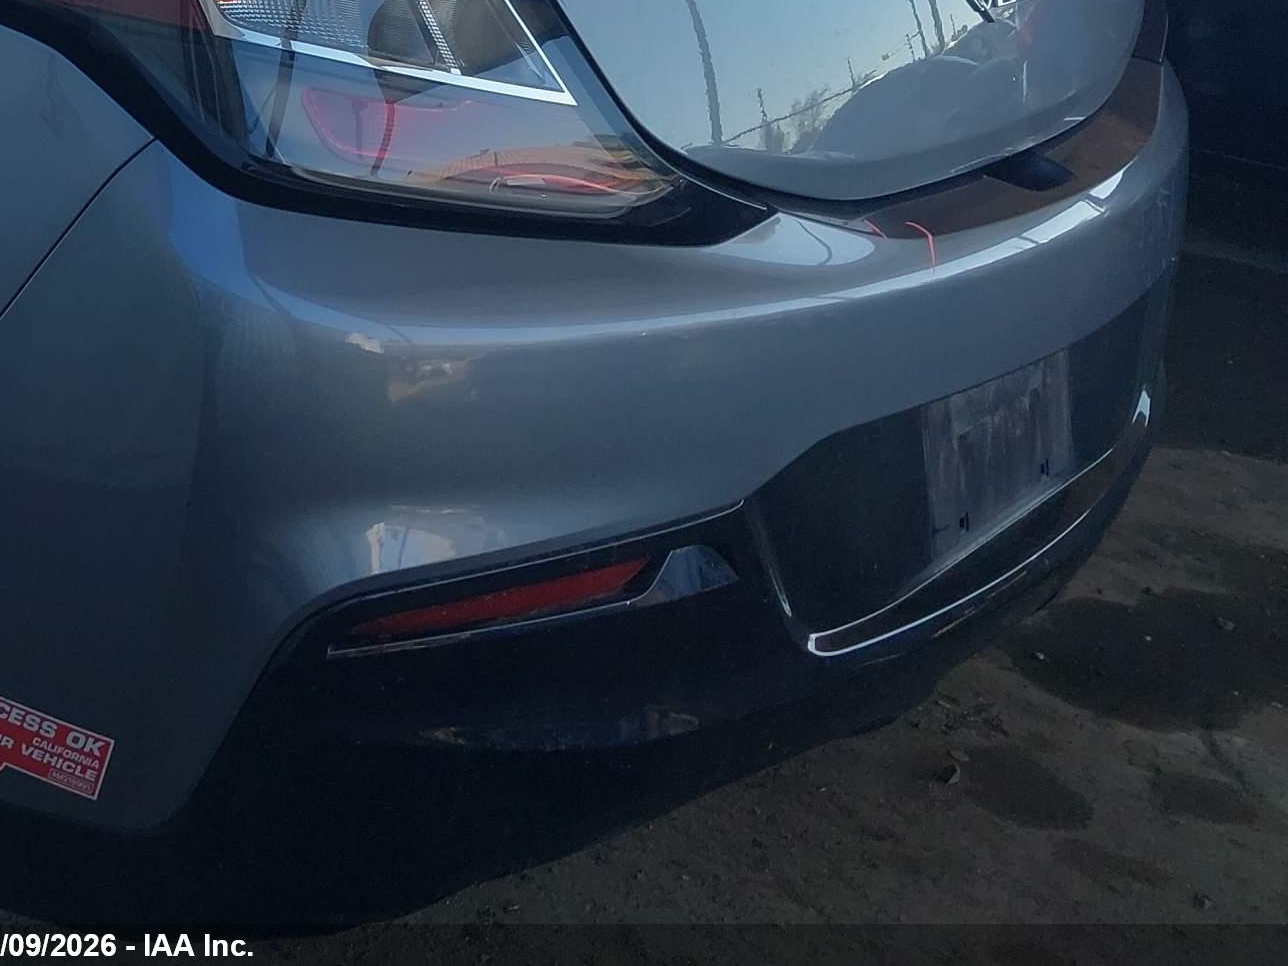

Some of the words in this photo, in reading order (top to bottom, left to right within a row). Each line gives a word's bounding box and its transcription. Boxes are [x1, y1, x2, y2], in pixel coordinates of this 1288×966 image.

[32, 737, 100, 769] CALIFORNIA
[65, 731, 106, 756] OK
[21, 744, 99, 782] VEHICLE
